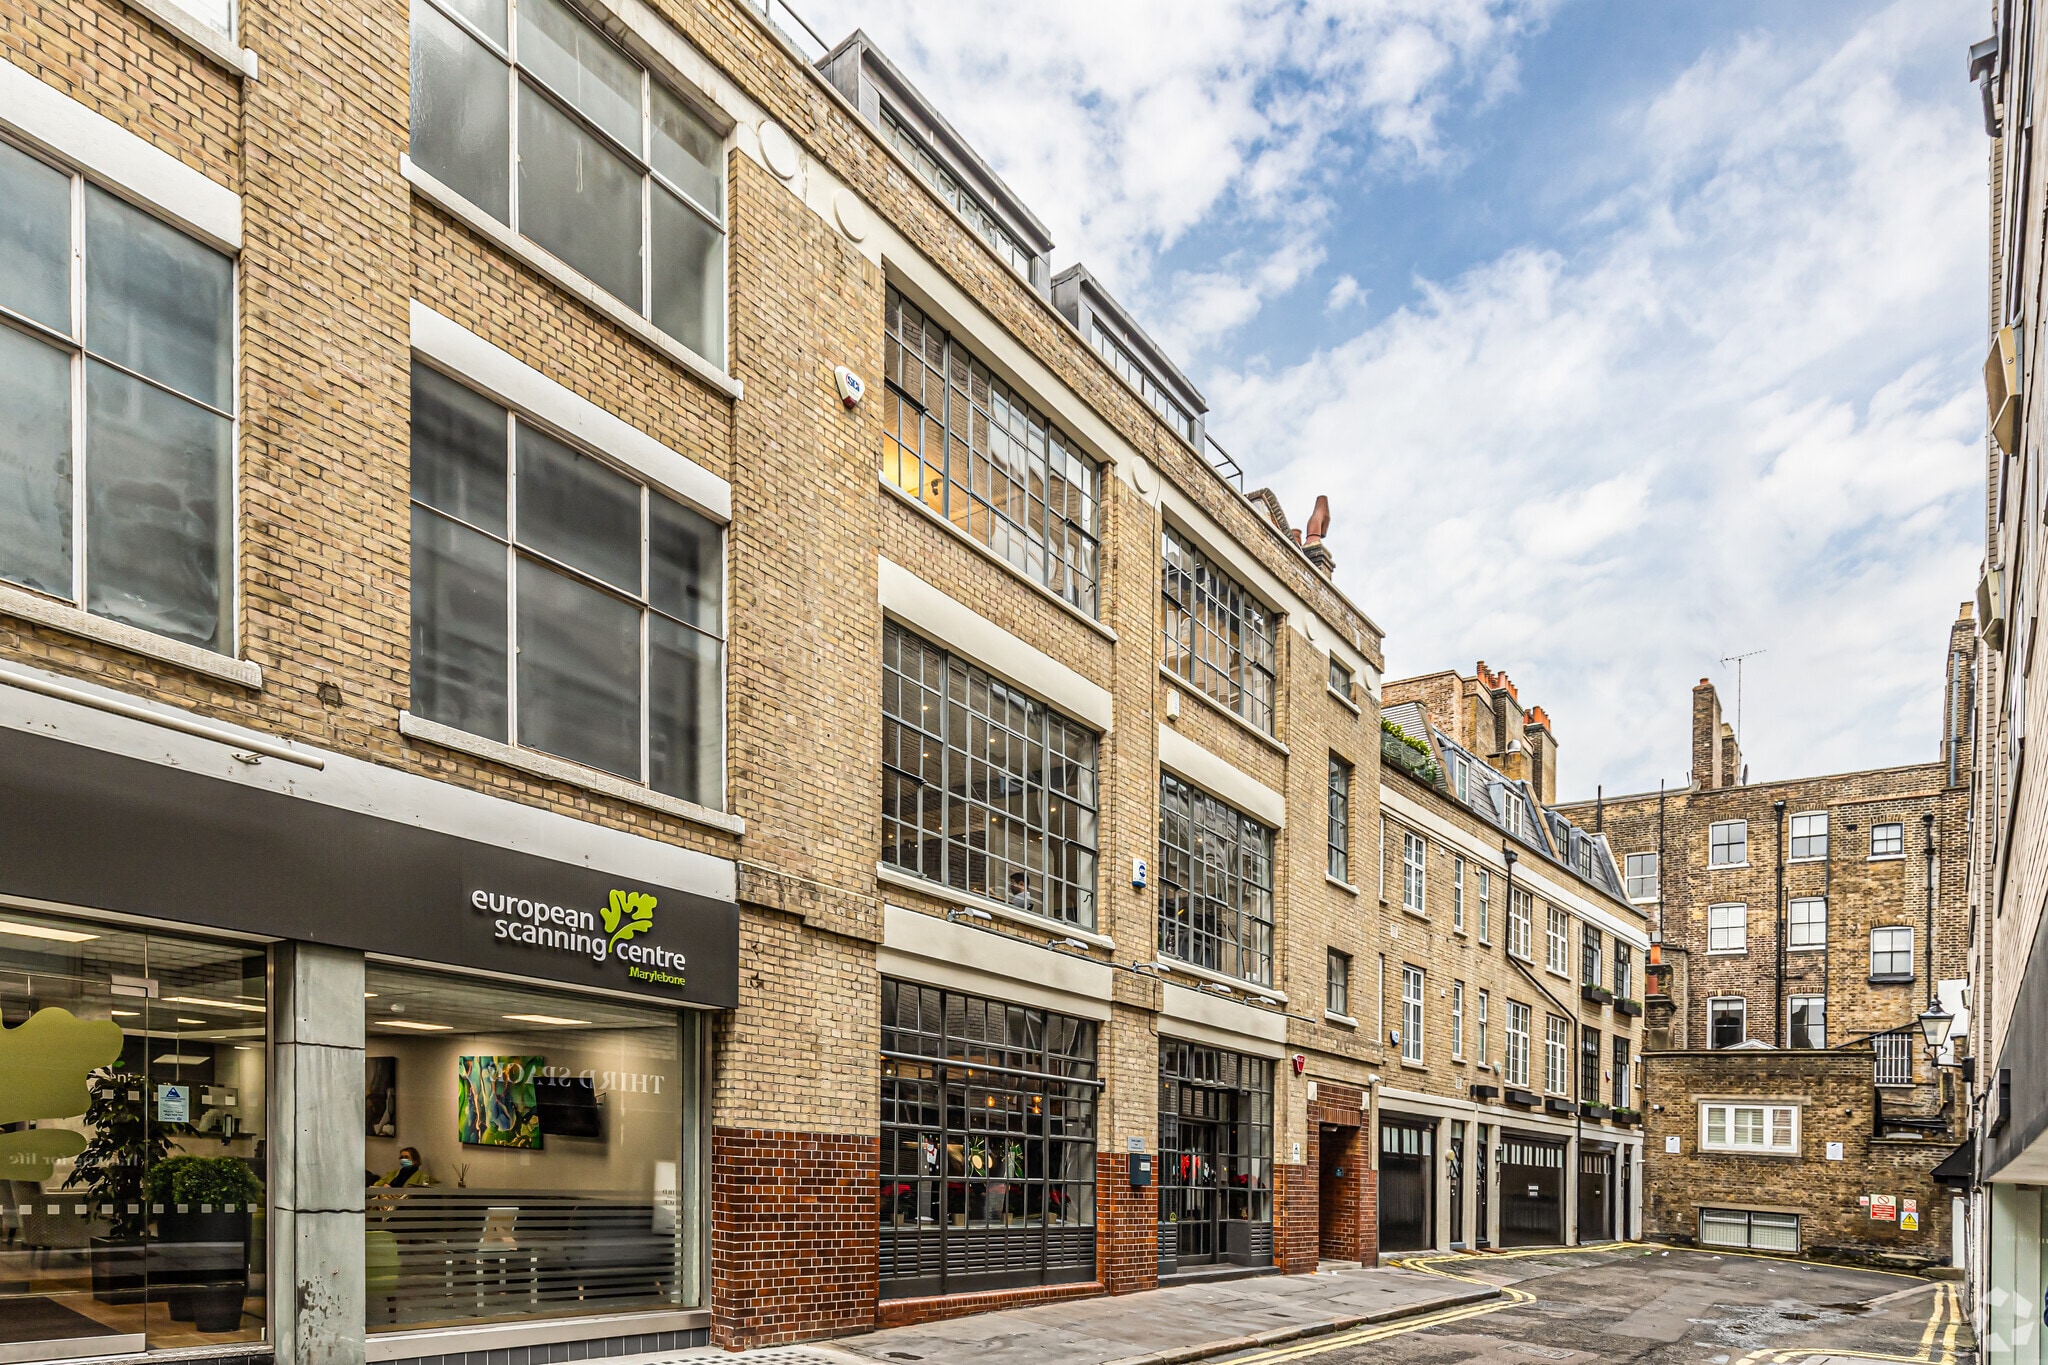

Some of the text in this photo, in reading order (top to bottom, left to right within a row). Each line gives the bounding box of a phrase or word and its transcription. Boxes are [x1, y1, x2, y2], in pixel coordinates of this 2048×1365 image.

[471, 889, 595, 931] european
[494, 918, 686, 971] scanning centre
[629, 966, 686, 986] Marylebone
